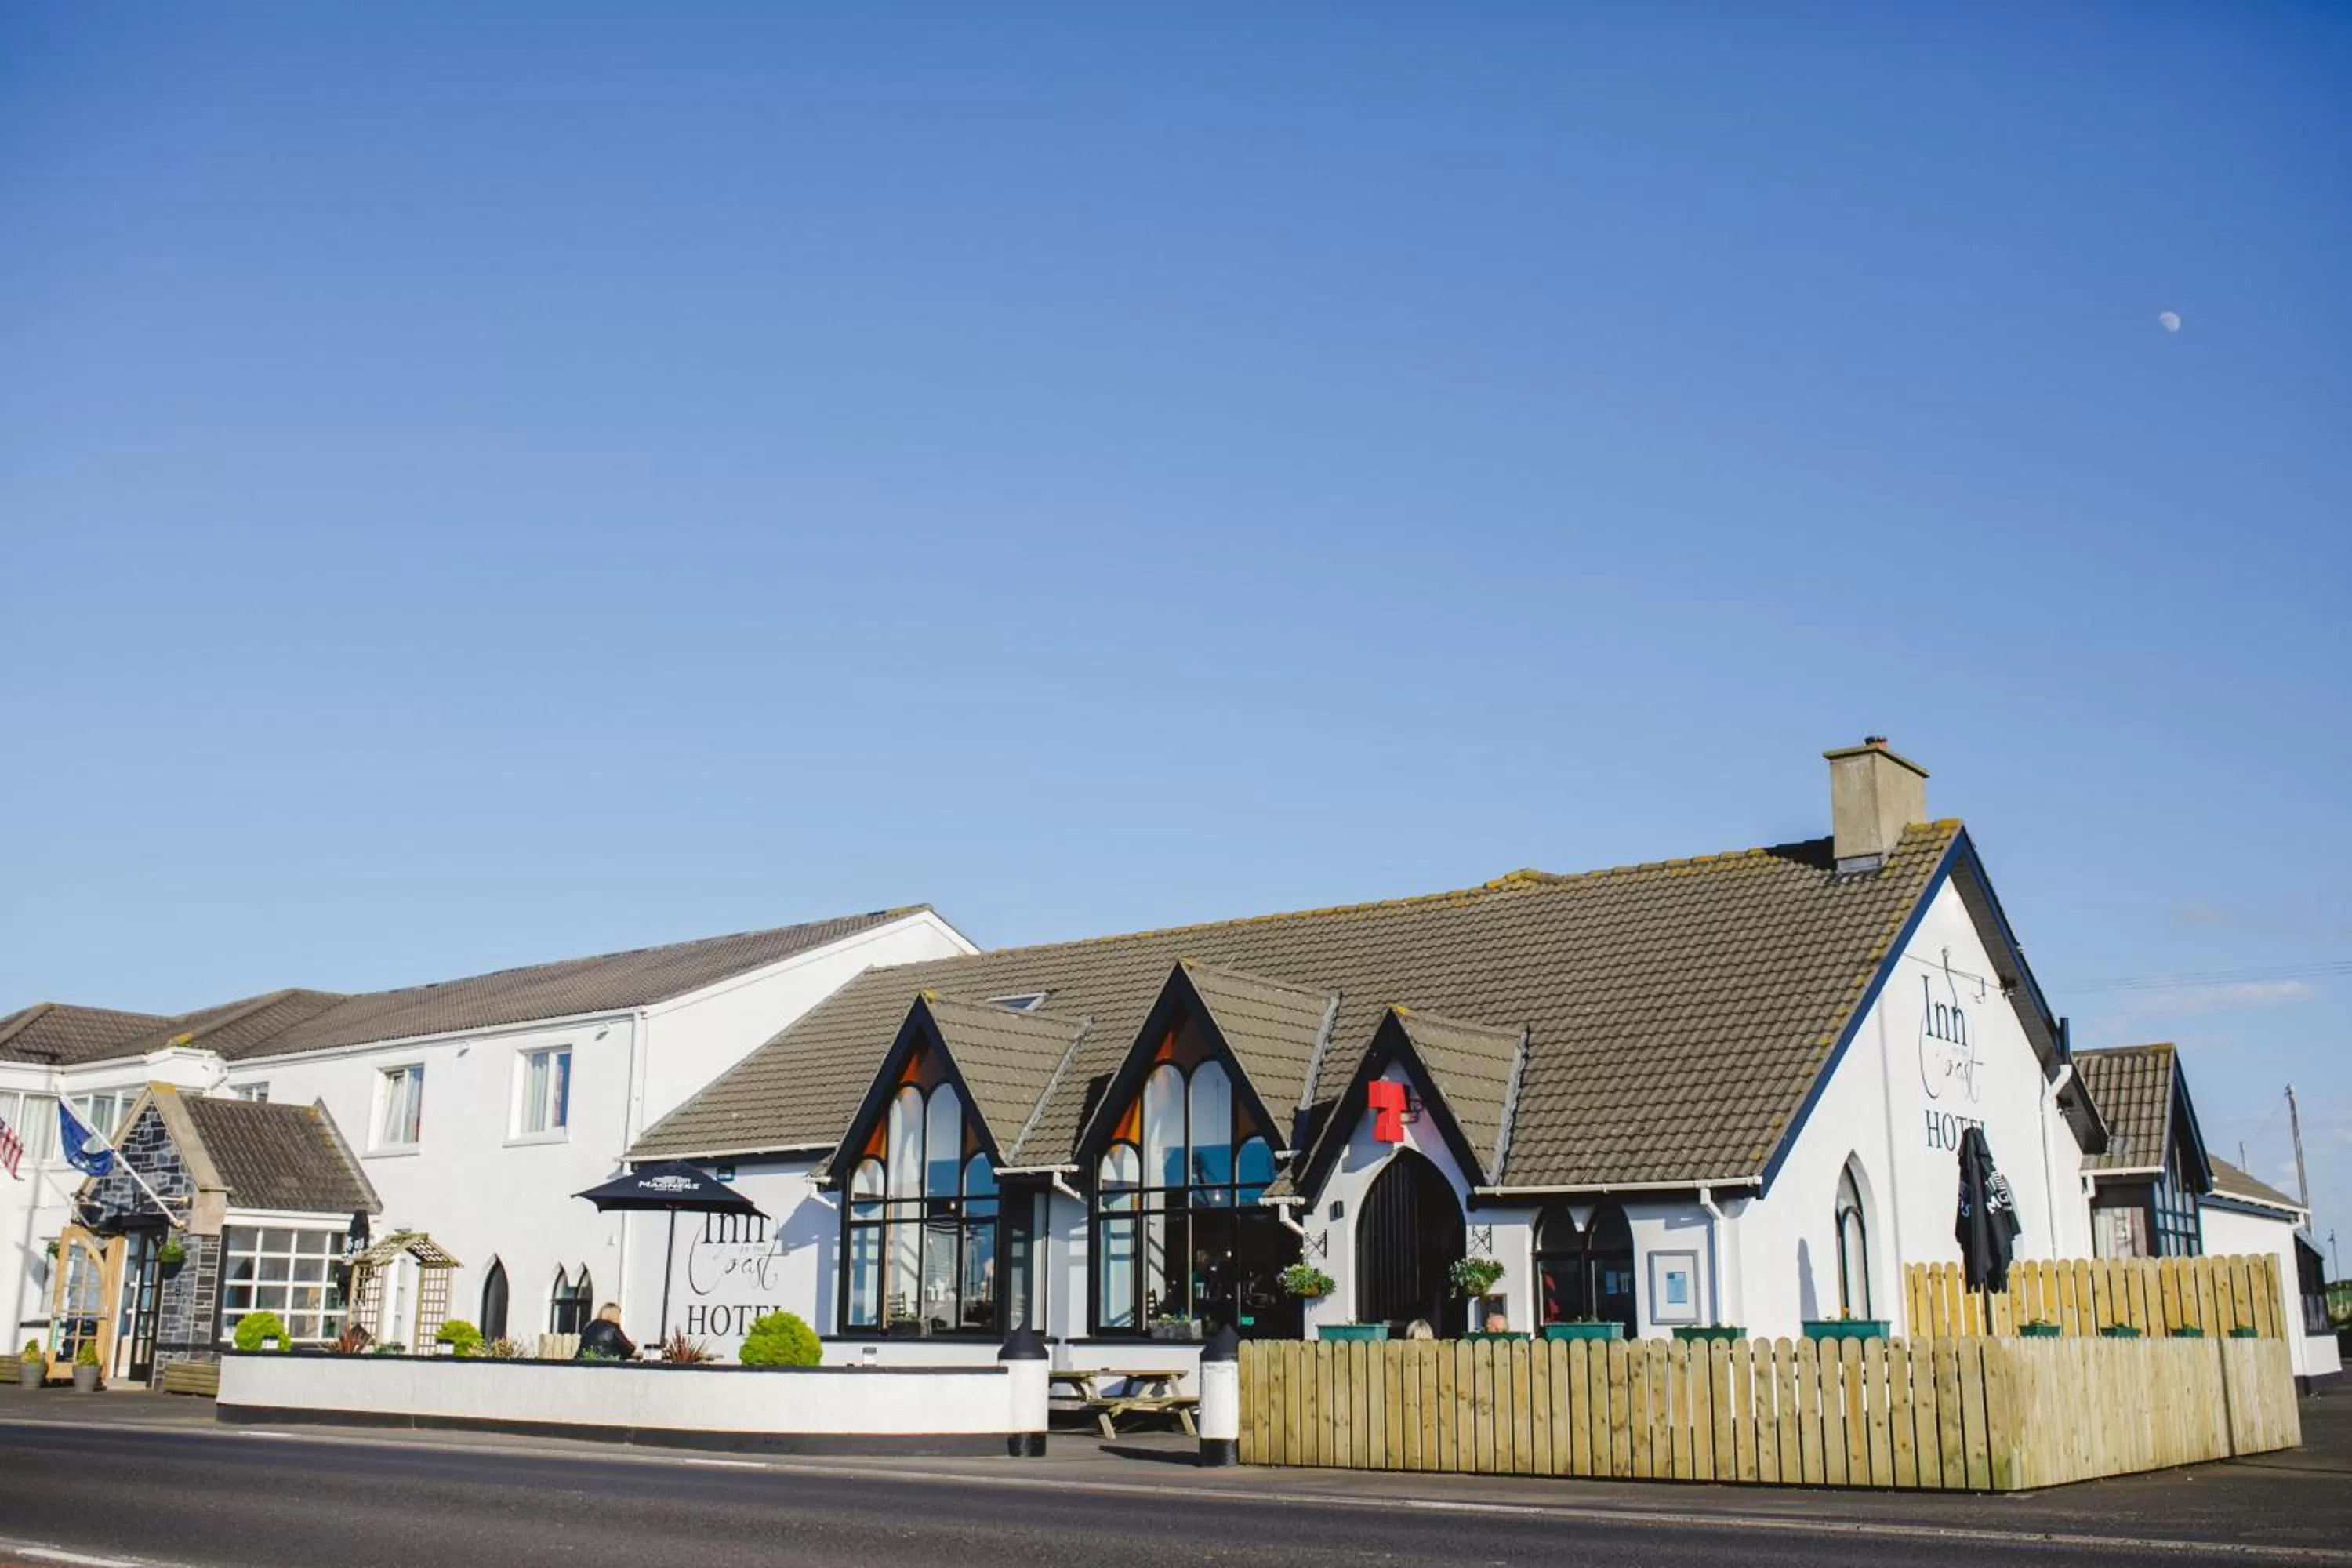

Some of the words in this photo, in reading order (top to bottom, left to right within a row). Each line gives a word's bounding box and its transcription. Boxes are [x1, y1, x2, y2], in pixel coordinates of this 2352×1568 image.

[1921, 975, 1967, 1047] Inn
[1926, 1109, 1985, 1152] HOT
[688, 1304, 782, 1336] HOT
